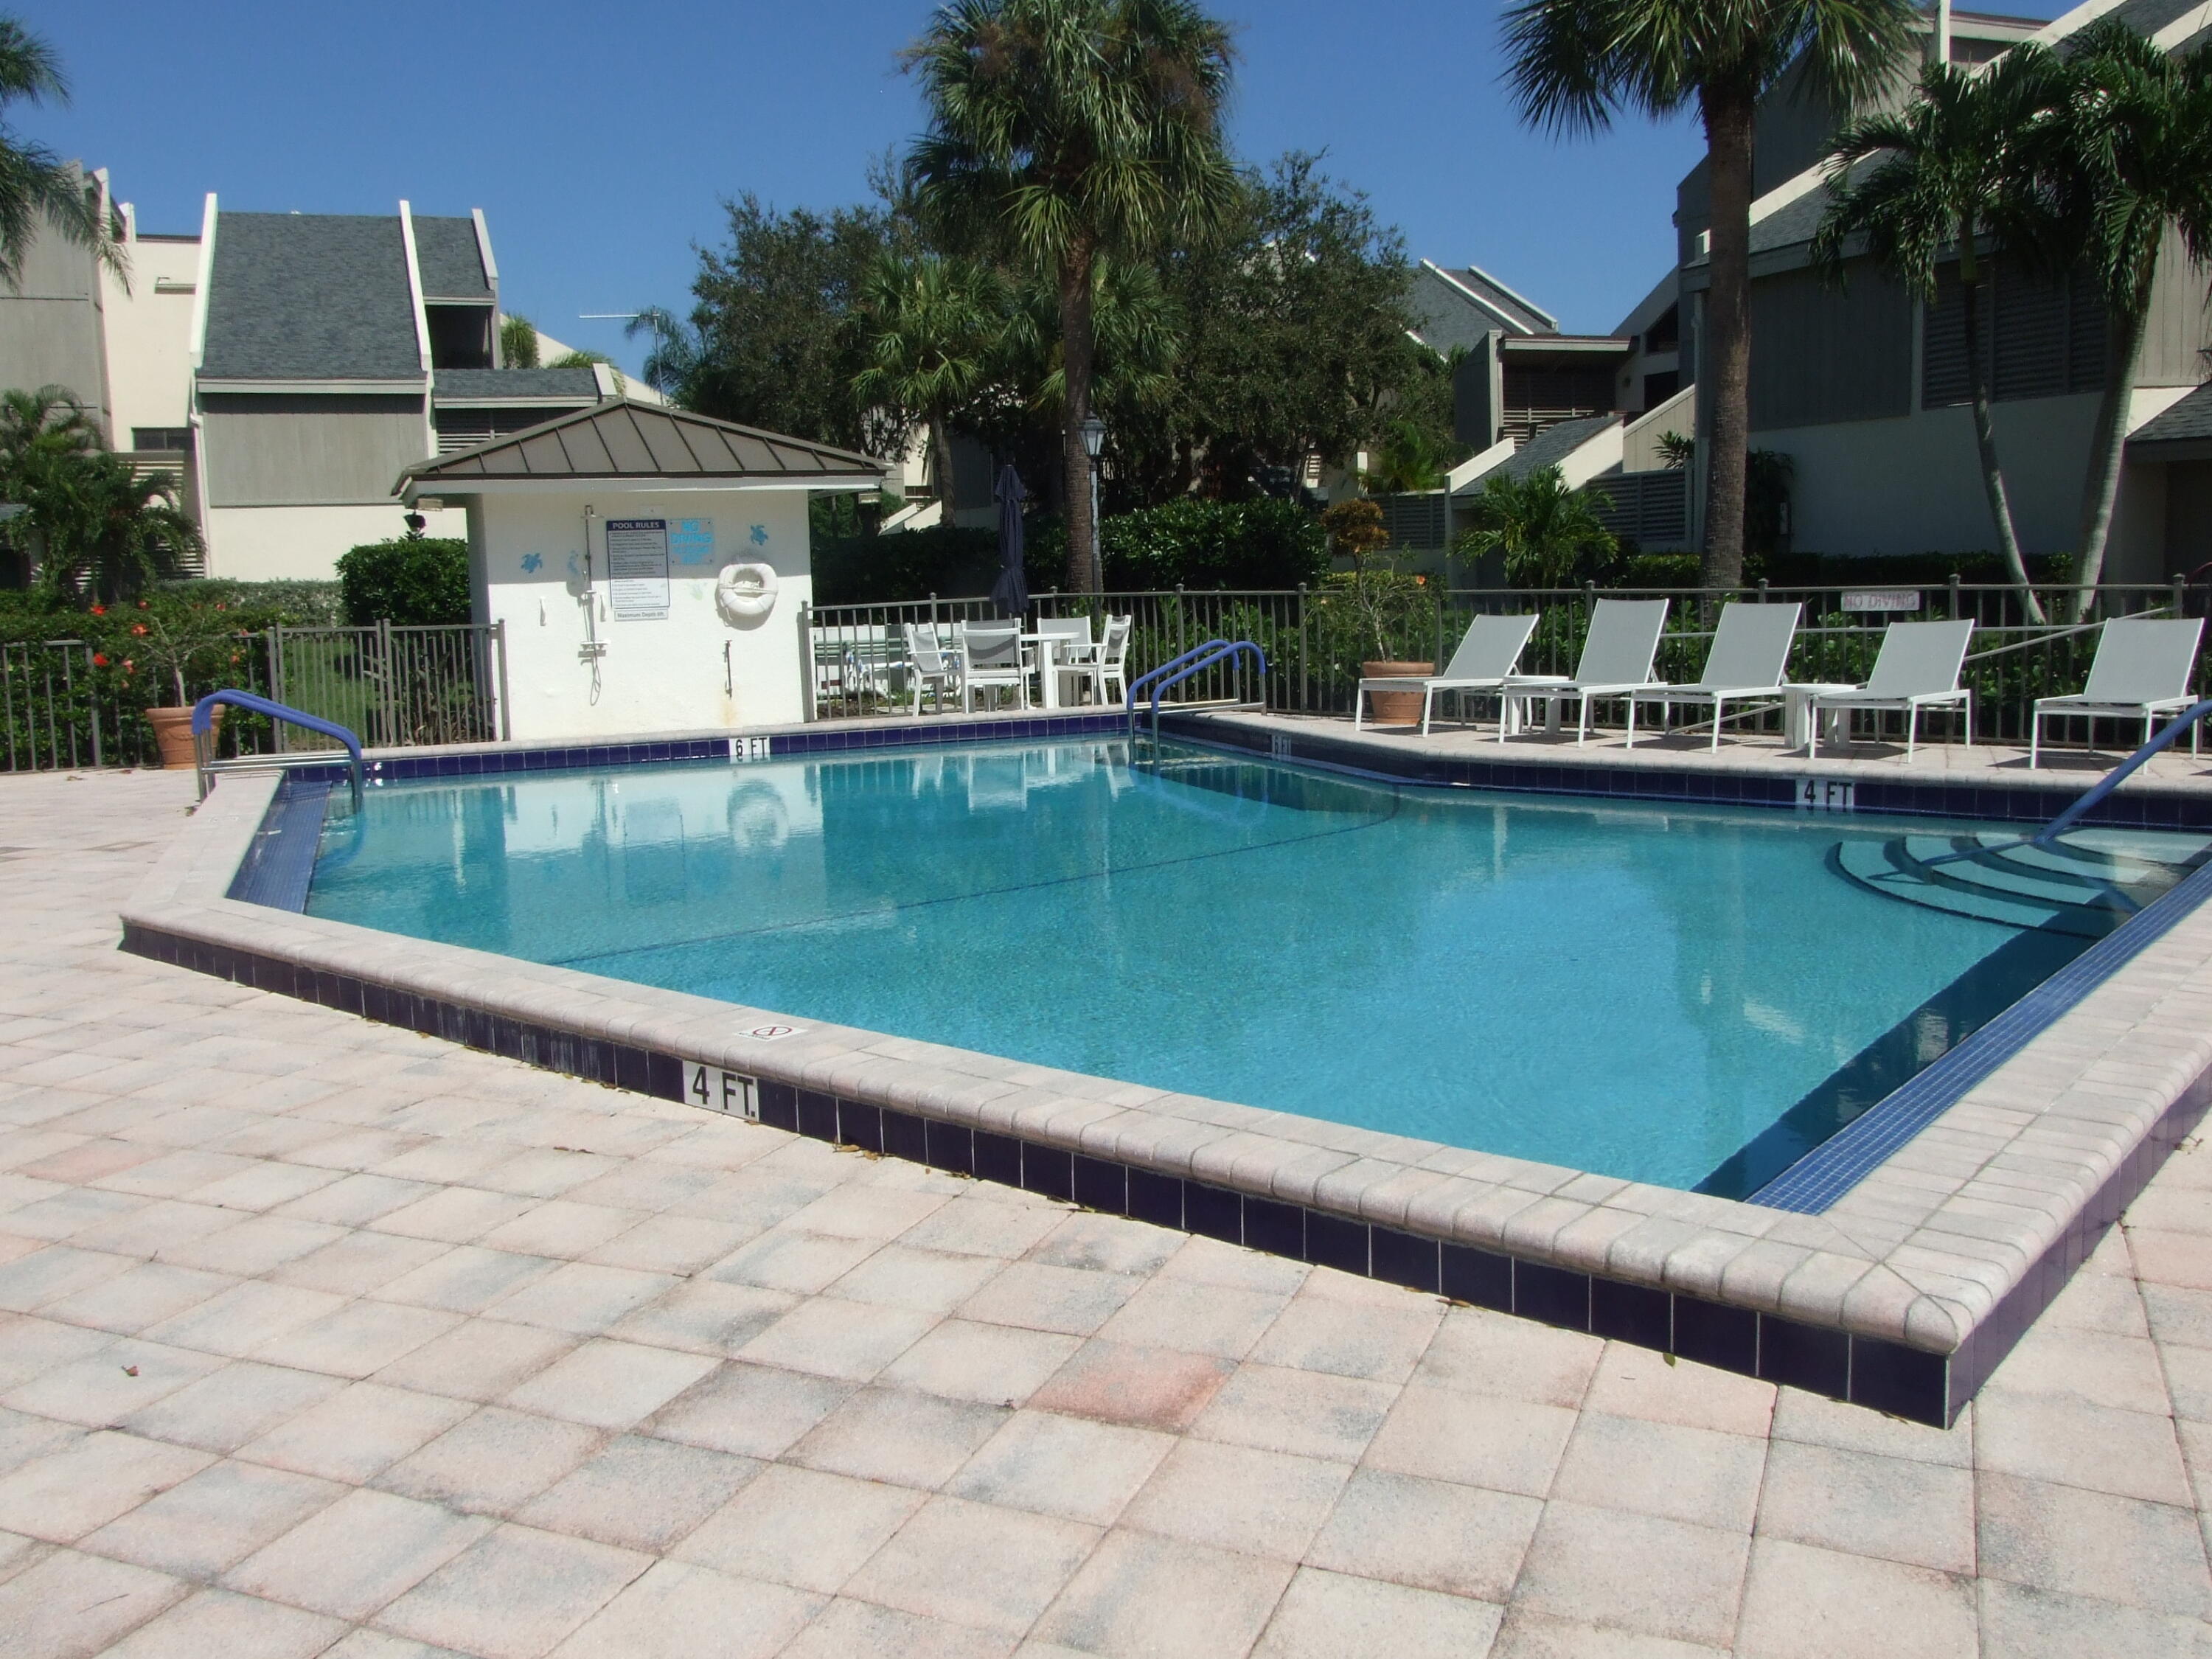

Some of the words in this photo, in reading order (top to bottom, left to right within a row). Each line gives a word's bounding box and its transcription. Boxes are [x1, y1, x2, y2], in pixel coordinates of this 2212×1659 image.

[682, 521, 698, 531] NO
[671, 532, 712, 543] DIVING
[1845, 595, 1863, 608] NO
[1869, 594, 1916, 608] DIVING
[736, 739, 743, 757] 6
[751, 737, 767, 756] FT
[1804, 780, 1816, 803] 4
[1826, 782, 1852, 805] FT
[692, 1066, 710, 1105] 4
[722, 1071, 756, 1117] FT.
